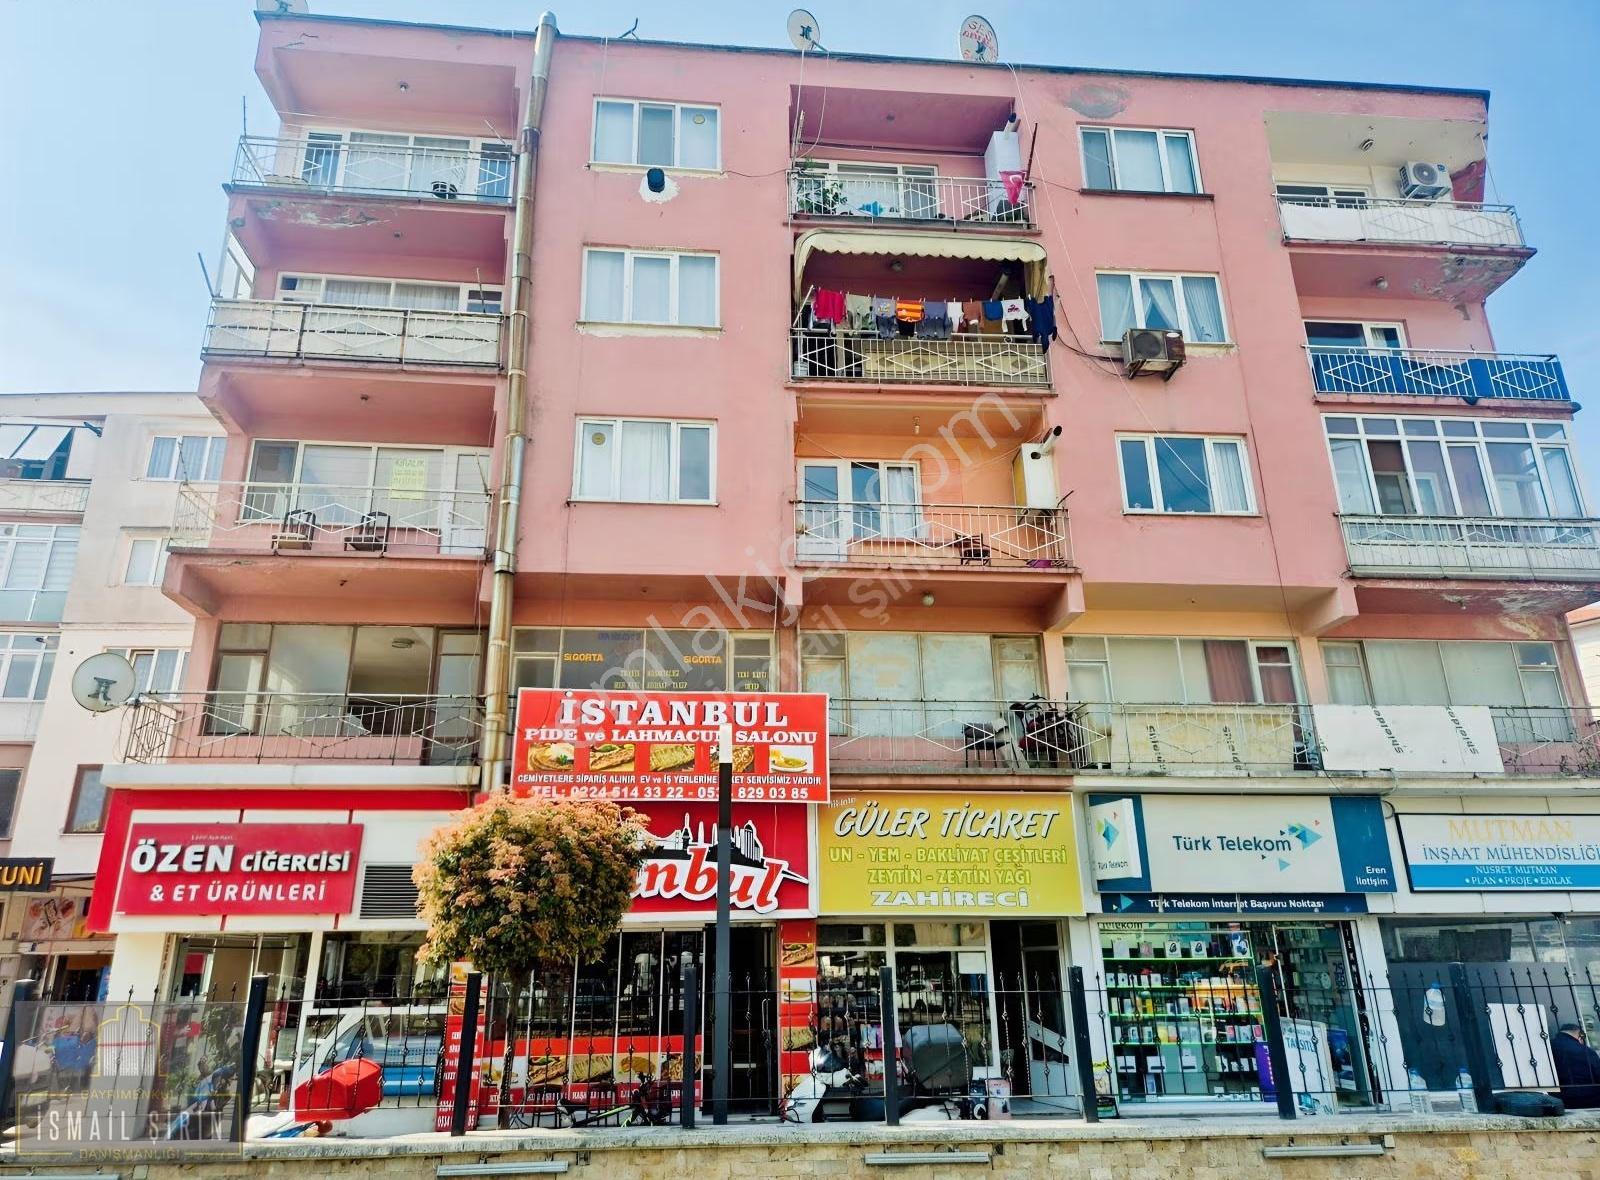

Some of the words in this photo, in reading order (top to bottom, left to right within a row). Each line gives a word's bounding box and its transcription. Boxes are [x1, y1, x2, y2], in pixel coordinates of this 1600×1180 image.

[558, 690, 788, 727] İSTANBUL
[523, 725, 578, 741] PİDE
[584, 731, 606, 742] ve
[735, 731, 818, 744] SALONU
[517, 773, 574, 784] CEMİYETLERE
[576, 773, 607, 785] SİPARİŞ
[609, 775, 636, 785] ALINIR
[640, 775, 649, 784] EV
[747, 774, 791, 786] SERVİSİMİZ
[793, 776, 821, 786] VARDIR
[644, 787, 661, 798] 33
[666, 787, 684, 798] 22
[738, 787, 765, 799] 829
[769, 787, 787, 799] 03
[791, 788, 808, 799] 85
[834, 800, 930, 839] GÜLER
[940, 802, 1060, 840] TİCARET
[1447, 818, 1576, 842] MUTMAN
[1172, 836, 1212, 851] Türk
[1217, 835, 1292, 851] Telekom
[1422, 843, 1480, 864] İNŞAAT
[130, 839, 235, 873] ÖZEN
[829, 847, 852, 862] UN
[869, 847, 900, 862] YEM
[916, 844, 989, 864] BAKLİYAT
[993, 845, 1067, 868] ÇEŞİTLERİ
[0, 862, 44, 886] UNİ
[868, 865, 922, 884] ZEYTİN
[937, 865, 991, 885] ZEYTİN
[994, 864, 1031, 885] YAĞI
[1366, 866, 1387, 874] Eren
[1475, 865, 1511, 875] NUSRET
[1515, 865, 1558, 875] MUTMAN
[150, 884, 164, 902] &
[172, 884, 201, 901] ET
[207, 879, 328, 901] ÜRÜNLERİ
[1472, 876, 1496, 885] PLAN
[1504, 876, 1532, 887] PROJE
[1540, 876, 1573, 885] EMLAK
[871, 887, 1030, 908] ZAHİRECİ
[1171, 899, 1210, 908] Telekom
[1250, 899, 1287, 909] Başvuru
[1288, 899, 1325, 908] Noktası
